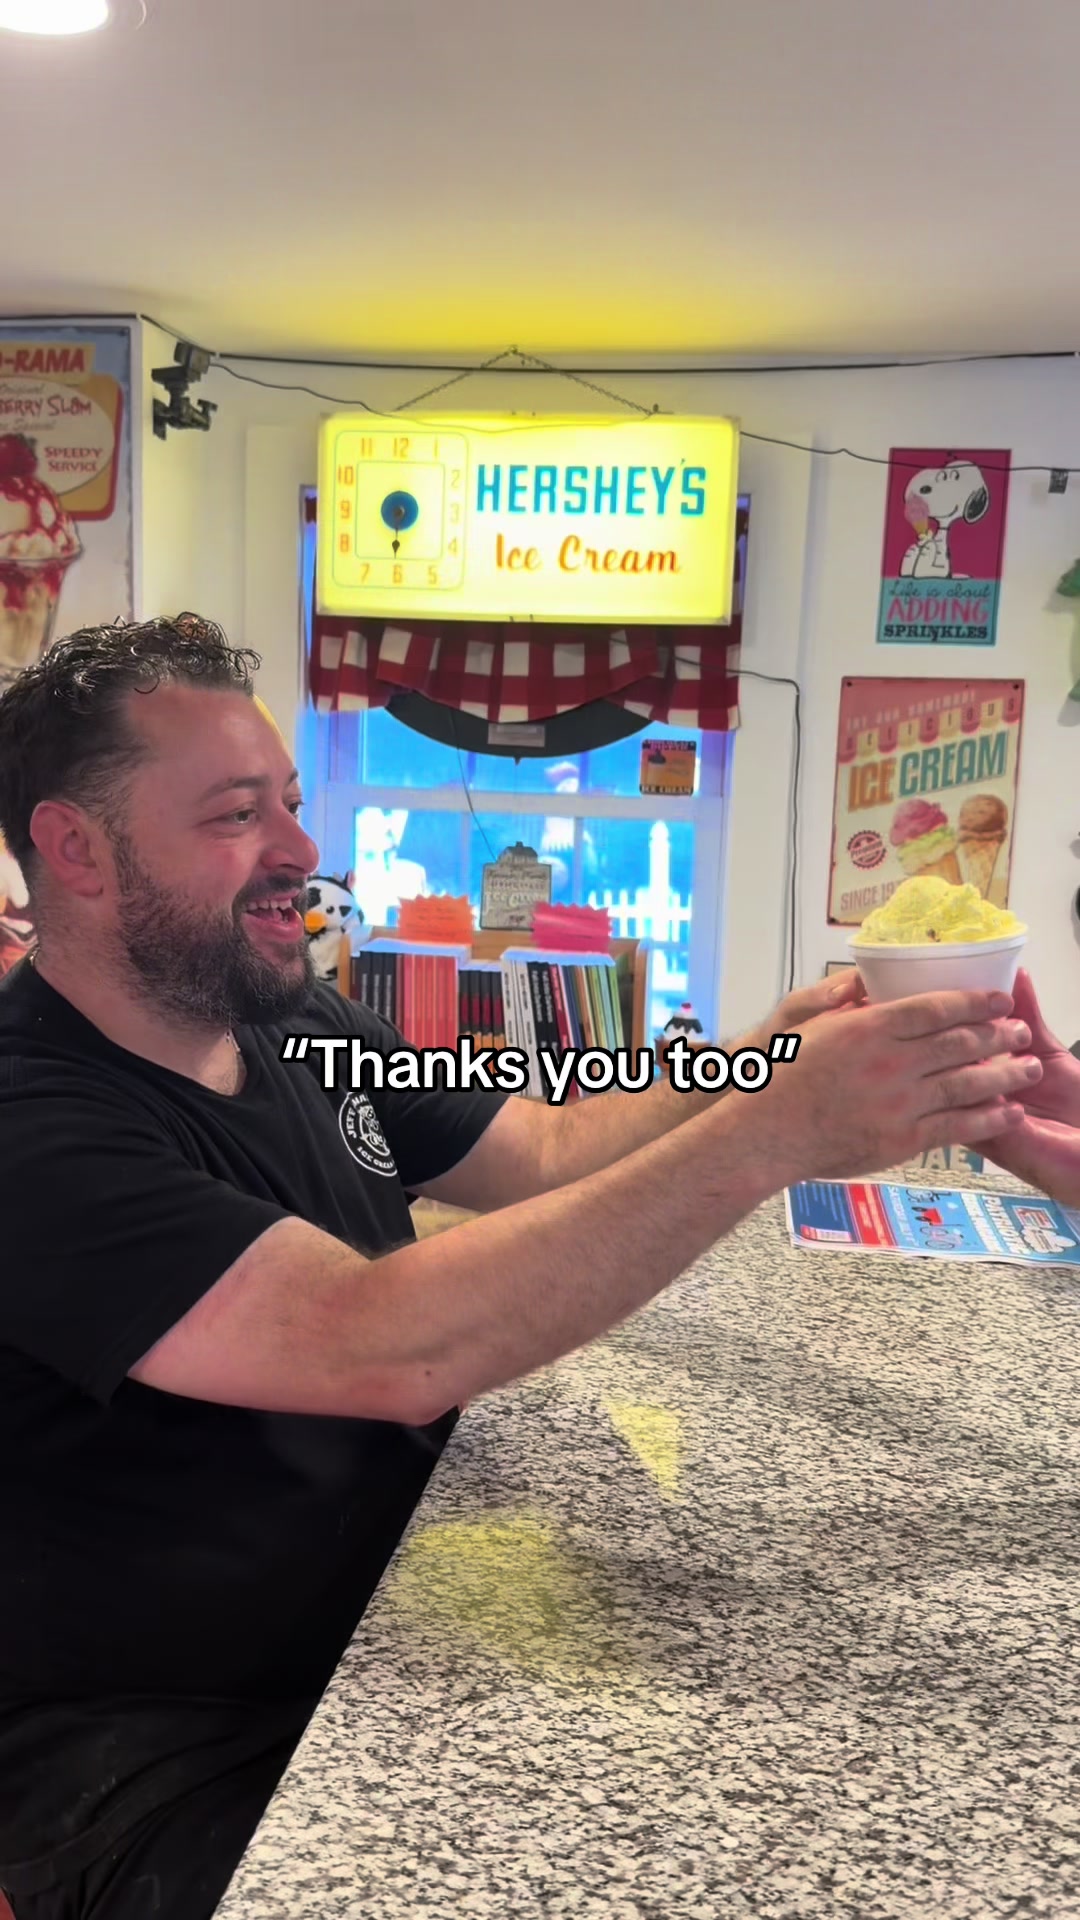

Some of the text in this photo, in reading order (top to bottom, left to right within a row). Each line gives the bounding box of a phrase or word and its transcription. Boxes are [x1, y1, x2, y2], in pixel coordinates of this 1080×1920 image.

[0, 348, 85, 373] -RAMA
[44, 447, 103, 459] SPEEDY
[393, 437, 410, 459] 12
[47, 461, 98, 473] SERVICE
[337, 465, 354, 486] 10
[476, 458, 707, 517] HERSHEY'S
[340, 500, 351, 519] 9
[339, 533, 350, 553] 8
[496, 533, 681, 575] Ice Cream
[361, 562, 371, 583] 7
[392, 564, 403, 584] 6
[427, 565, 438, 585] 5
[945, 583, 991, 599] about
[887, 597, 989, 625] ADDING
[884, 624, 988, 642] SPRINKLES
[848, 730, 1010, 813] ICE CREAM
[840, 886, 878, 912] SINCE
[346, 1107, 357, 1138] JEFF
